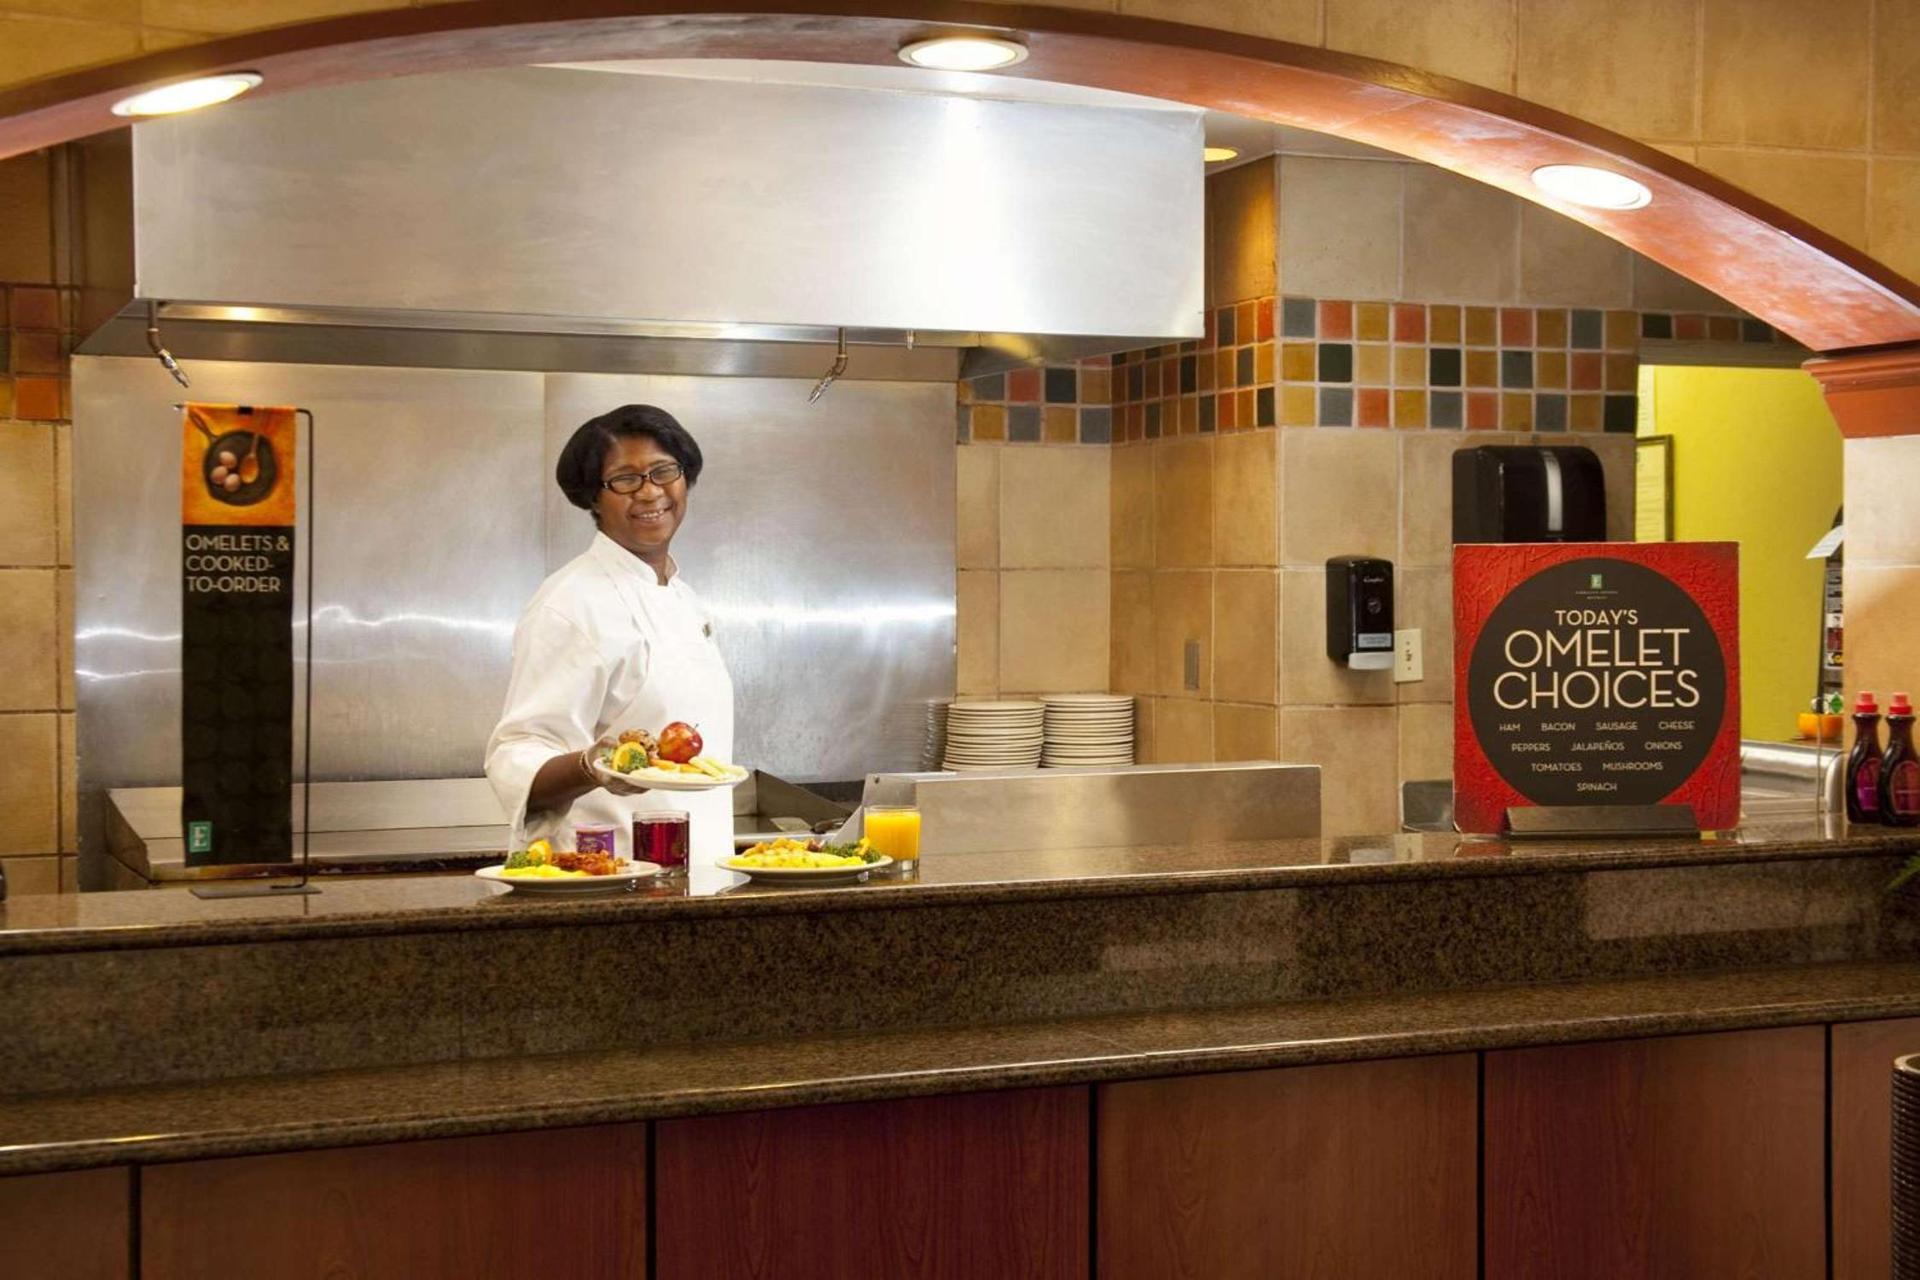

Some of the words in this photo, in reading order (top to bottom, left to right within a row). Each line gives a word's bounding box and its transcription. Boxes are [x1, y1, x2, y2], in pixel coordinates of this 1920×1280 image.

[185, 534, 273, 551] OMELETS
[275, 535, 290, 551] &
[185, 555, 275, 572] COOKED-
[186, 576, 281, 592] TO-ORDER
[1555, 610, 1639, 626] TODAY'S
[1504, 628, 1690, 668] OMELET
[1493, 669, 1700, 710] CHOICES
[1499, 723, 1521, 732] HAM
[1541, 723, 1576, 732] BACON
[1596, 721, 1638, 731] SAUSAGE
[1658, 721, 1695, 730] CHEESE
[1511, 743, 1551, 752] PEPPERS
[1571, 740, 1625, 751] JALAPEÑOS
[1644, 741, 1683, 751] ONIONS
[1531, 763, 1583, 772] TOMATOES
[1602, 762, 1664, 771] MUSHROOMS
[1577, 782, 1617, 792] SPINACH
